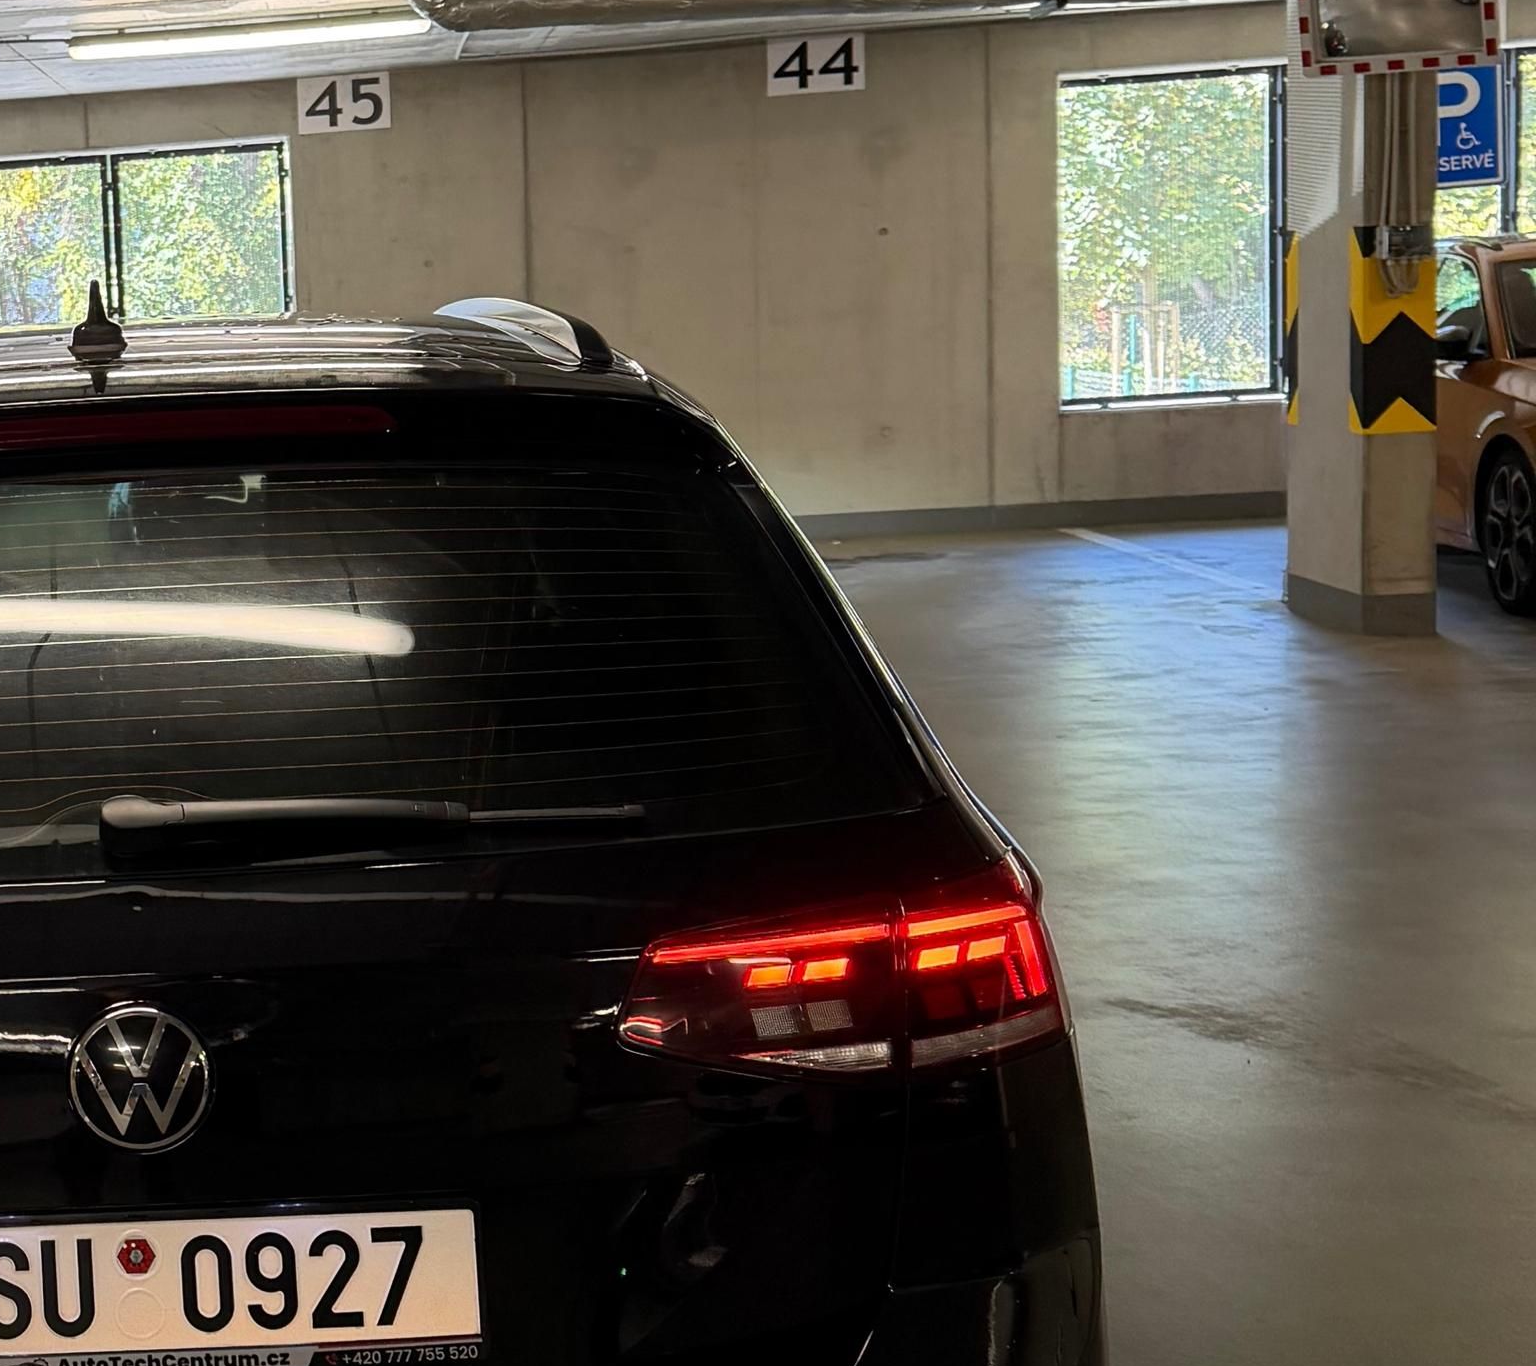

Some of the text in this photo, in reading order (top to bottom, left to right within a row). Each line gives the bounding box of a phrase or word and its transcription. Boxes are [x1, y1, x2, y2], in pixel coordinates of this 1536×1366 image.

[772, 37, 860, 89] 44
[304, 75, 385, 128] 45
[1439, 149, 1495, 172] SERVÉ
[180, 1226, 424, 1333] 0927
[341, 1344, 479, 1366] +420 777 755 520
